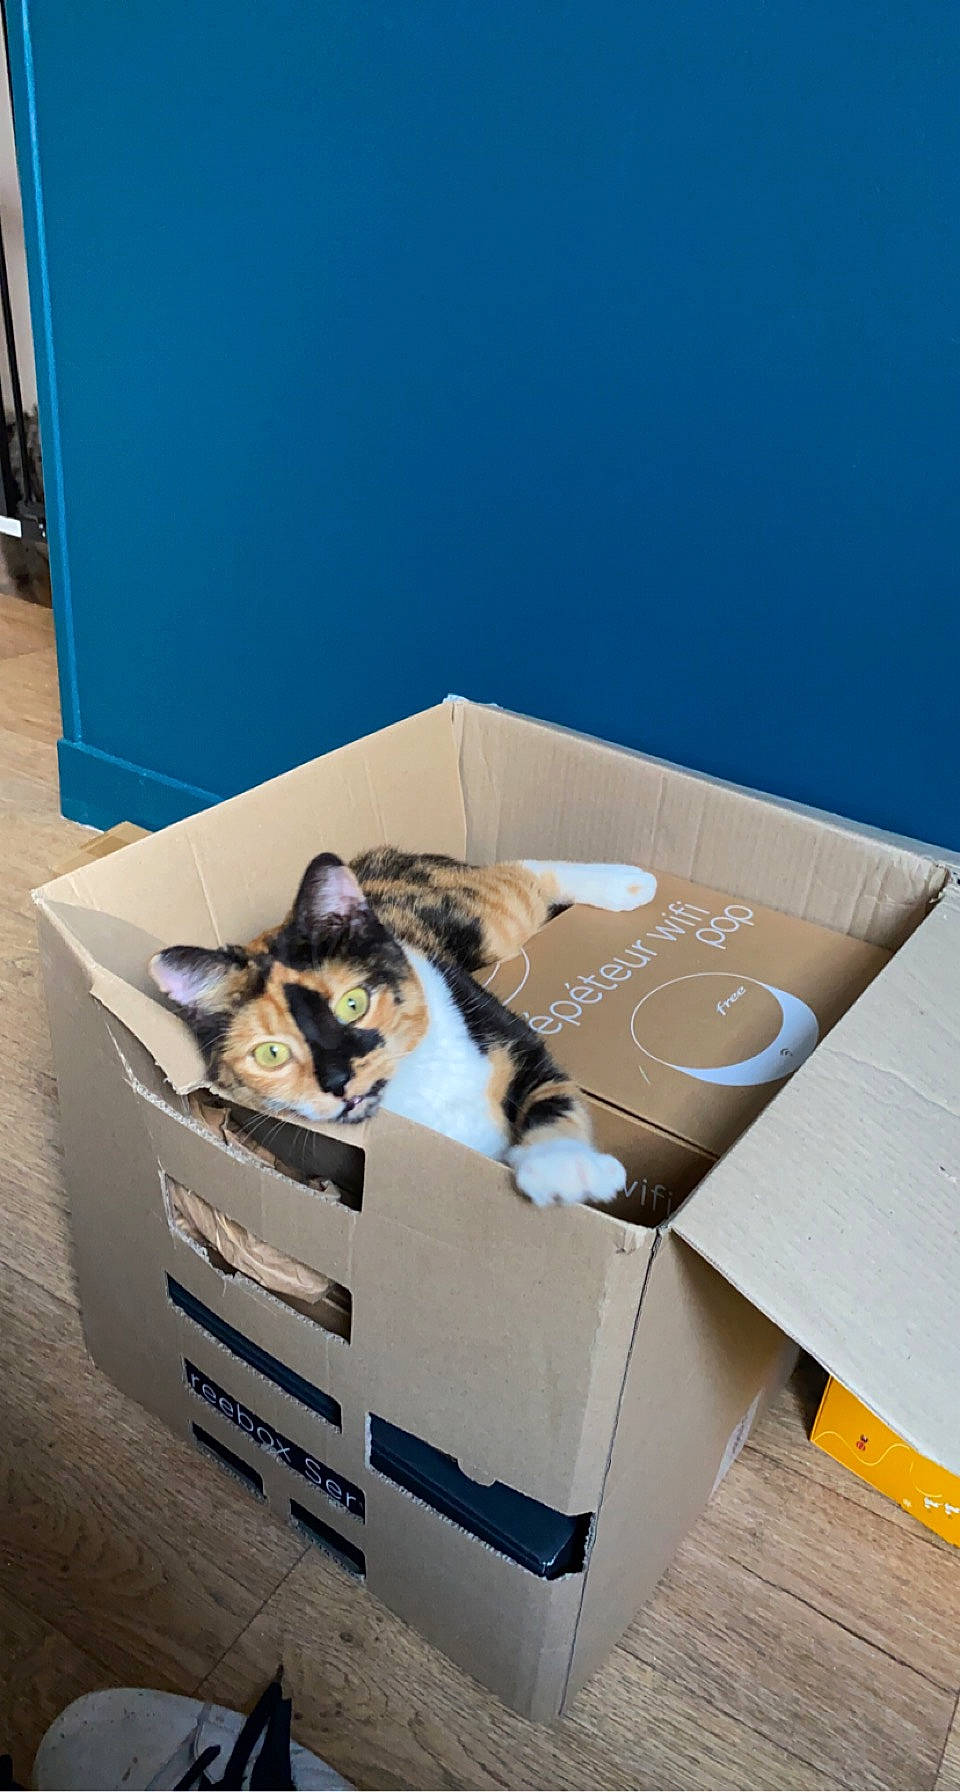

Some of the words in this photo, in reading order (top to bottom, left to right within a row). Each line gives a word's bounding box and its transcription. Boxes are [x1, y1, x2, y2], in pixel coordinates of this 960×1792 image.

[522, 939, 657, 1035] épéteur
[646, 900, 711, 942] wifi
[695, 904, 755, 950] pop
[715, 985, 747, 1016] free
[190, 1372, 292, 1463] reebox
[304, 1457, 363, 1510] Ser
